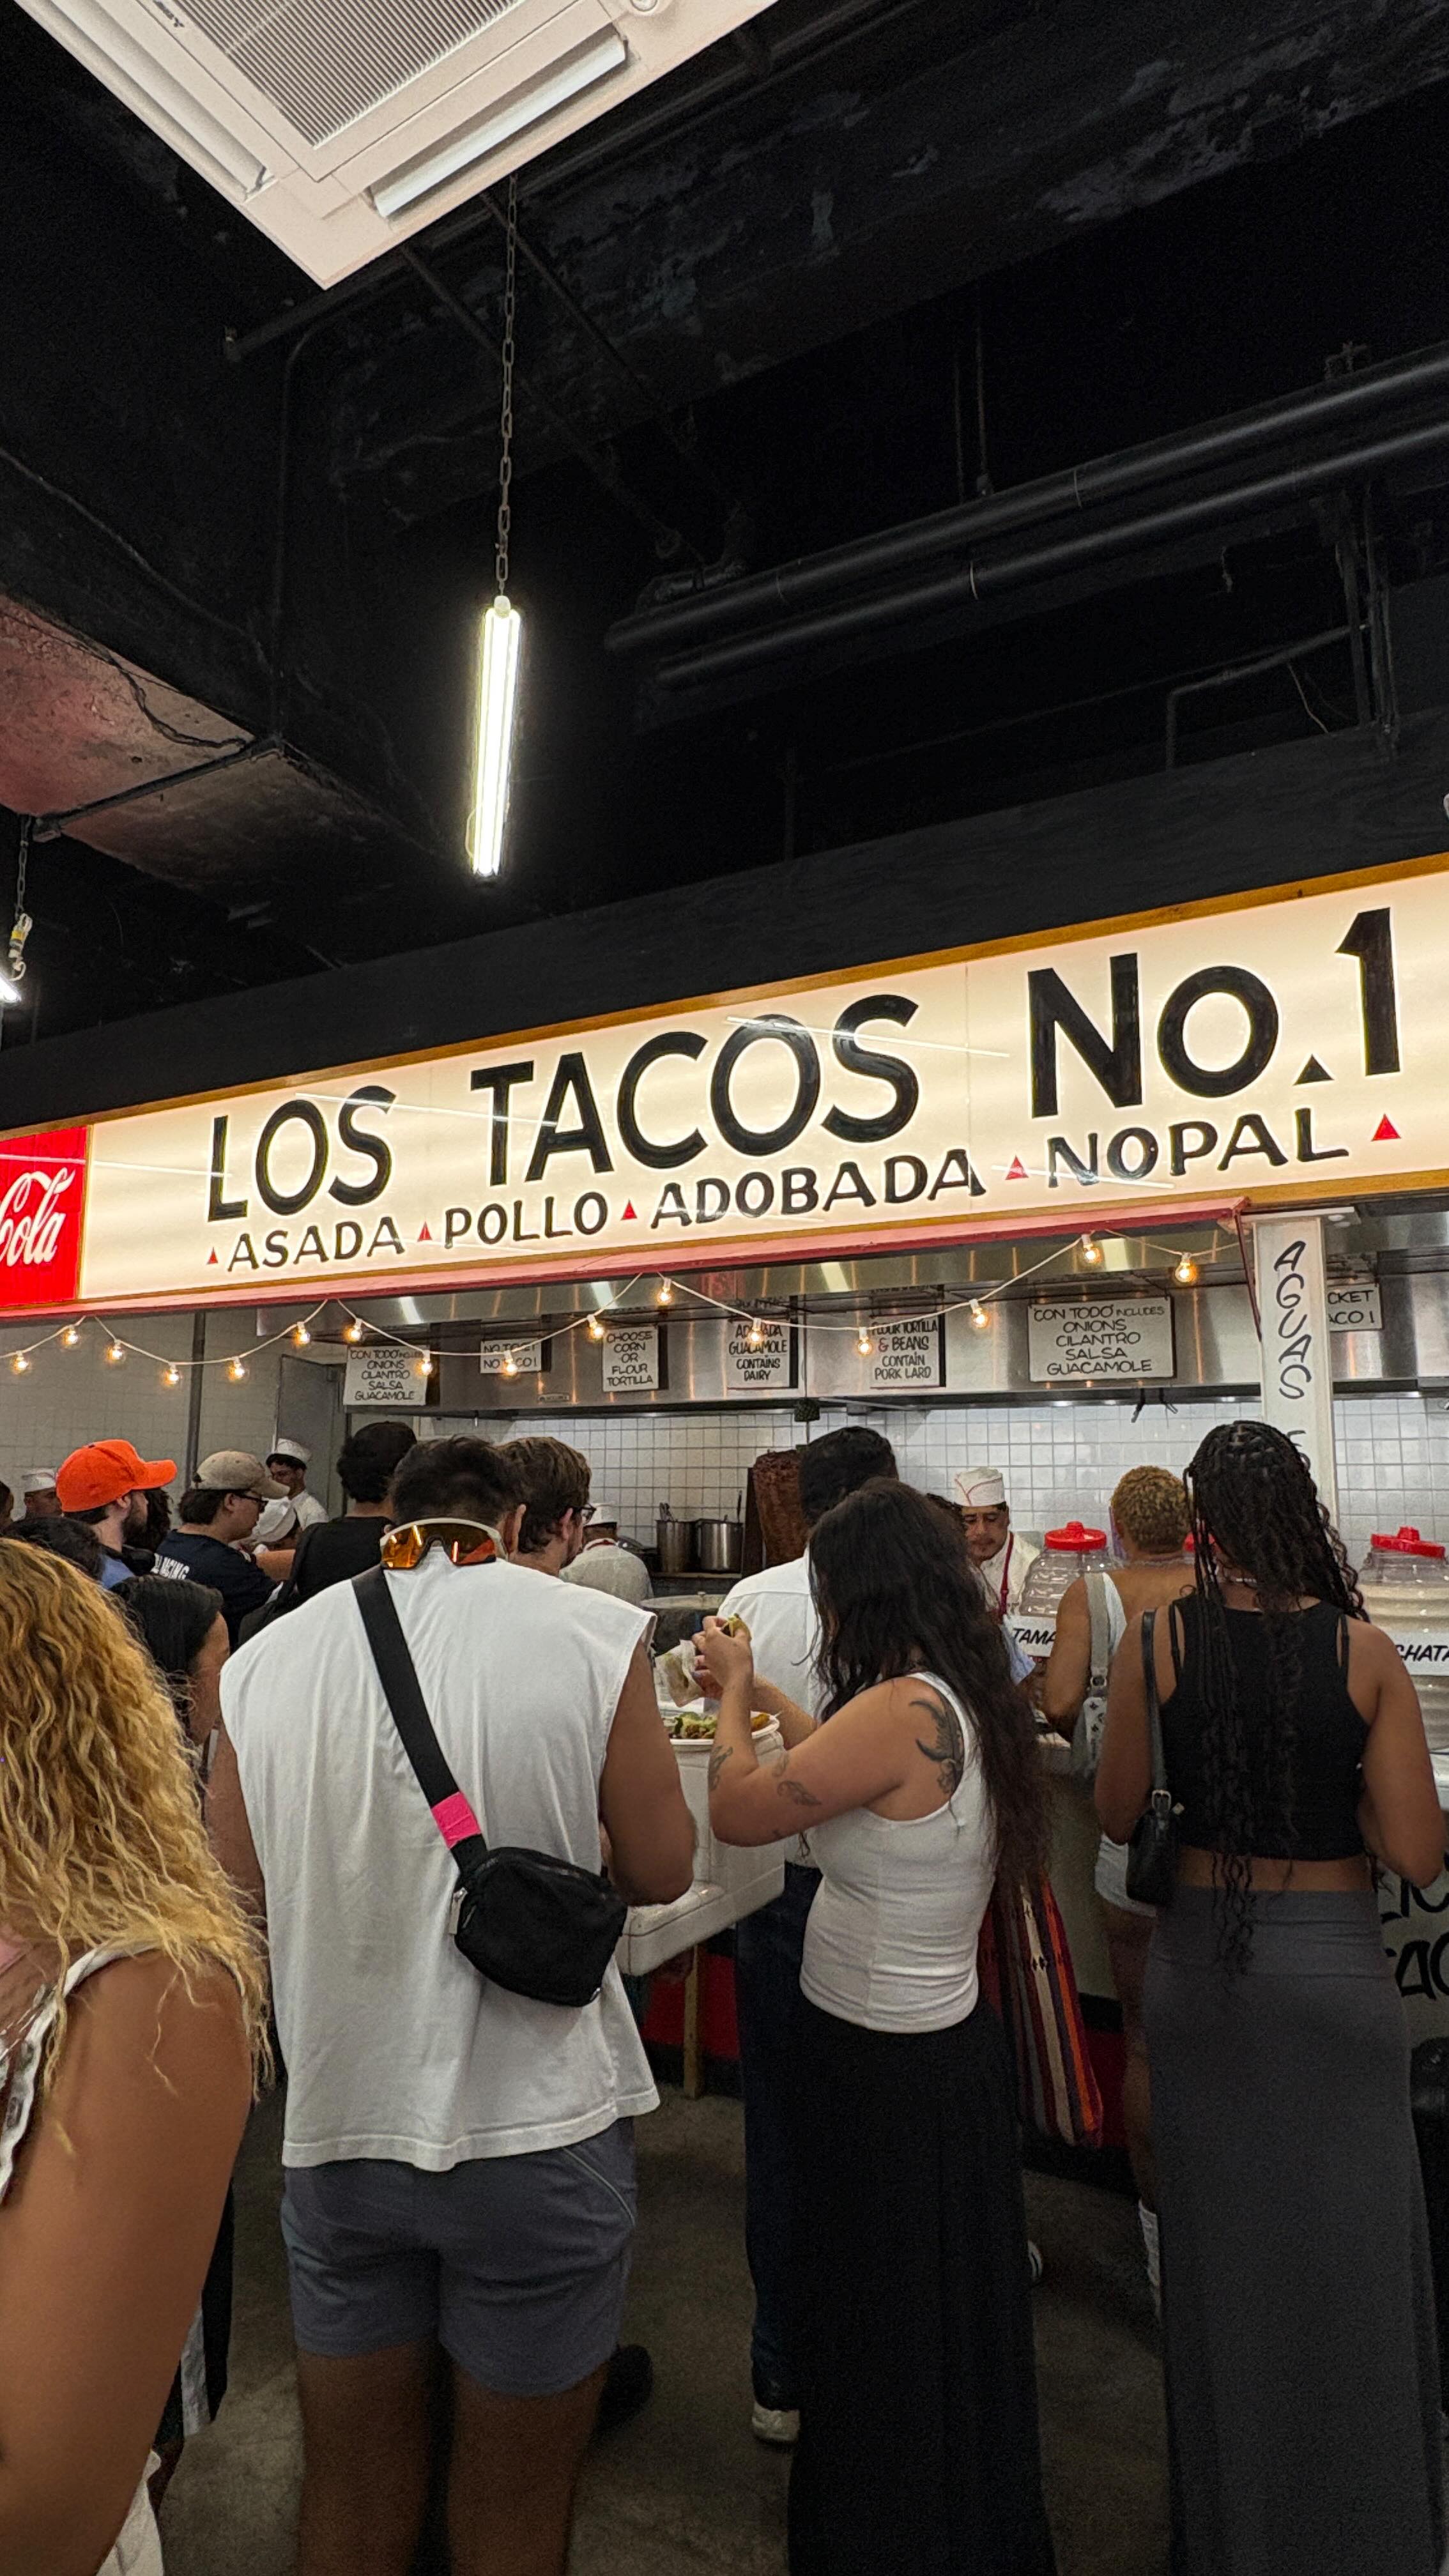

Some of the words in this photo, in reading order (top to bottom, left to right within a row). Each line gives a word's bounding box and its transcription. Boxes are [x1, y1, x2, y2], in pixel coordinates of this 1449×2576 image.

[208, 1085, 397, 1222] LOS
[470, 994, 919, 1186] TACOS
[227, 1216, 405, 1272] ASADA
[445, 1192, 608, 1250] POLLO
[650, 1148, 986, 1229] ADOBADA
[1048, 1108, 1349, 1189] NOPAL
[1063, 1319, 1127, 1334] ONIONS
[1273, 1241, 1312, 1400] AGUAS
[607, 1330, 653, 1344] CHOOSE
[878, 1337, 889, 1352] &
[892, 1335, 930, 1351] BEANS
[1056, 1331, 1141, 1347] CILANTRO
[614, 1342, 645, 1353] CORN
[1066, 1347, 1128, 1361] SALSA
[367, 1360, 405, 1369] ONIONS
[484, 1358, 501, 1368] NO
[622, 1352, 639, 1363] OR
[611, 1363, 648, 1375] FLOUR
[874, 1367, 902, 1381] PORK
[905, 1366, 931, 1379] LARD
[1047, 1359, 1153, 1376] GUACAMOLE
[606, 1374, 654, 1386] TORTILLA
[744, 1370, 772, 1381] DAIRY
[368, 1381, 403, 1390] SALSA
[354, 1390, 415, 1400] GUACAMOLE
